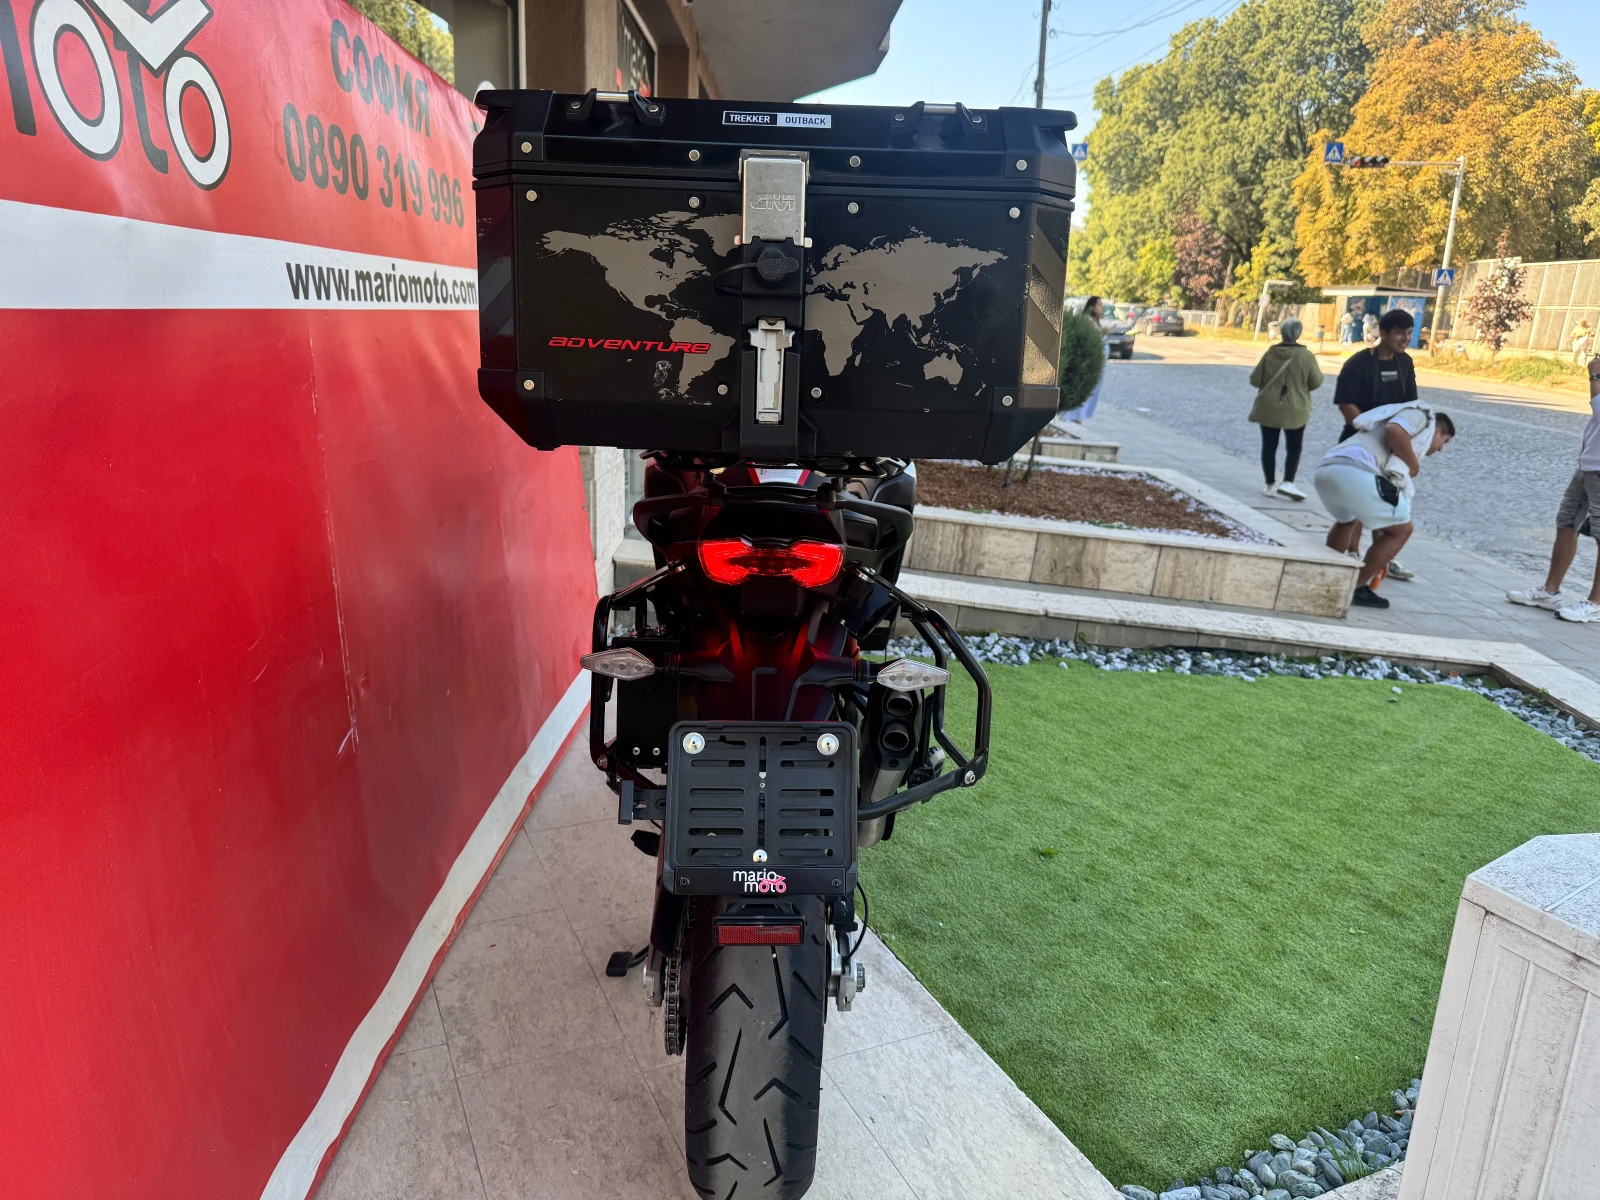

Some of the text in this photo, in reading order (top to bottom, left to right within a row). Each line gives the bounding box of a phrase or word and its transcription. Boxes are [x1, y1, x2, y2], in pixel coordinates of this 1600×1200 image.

[330, 18, 431, 138] СОФИЯ
[729, 114, 826, 126] TREKKER OUTBACK
[283, 102, 465, 228] 0890 319 996
[749, 193, 796, 212] GIVI
[286, 262, 478, 306] www.mariomoto.com
[733, 868, 777, 882] mario
[744, 880, 787, 893] moto
